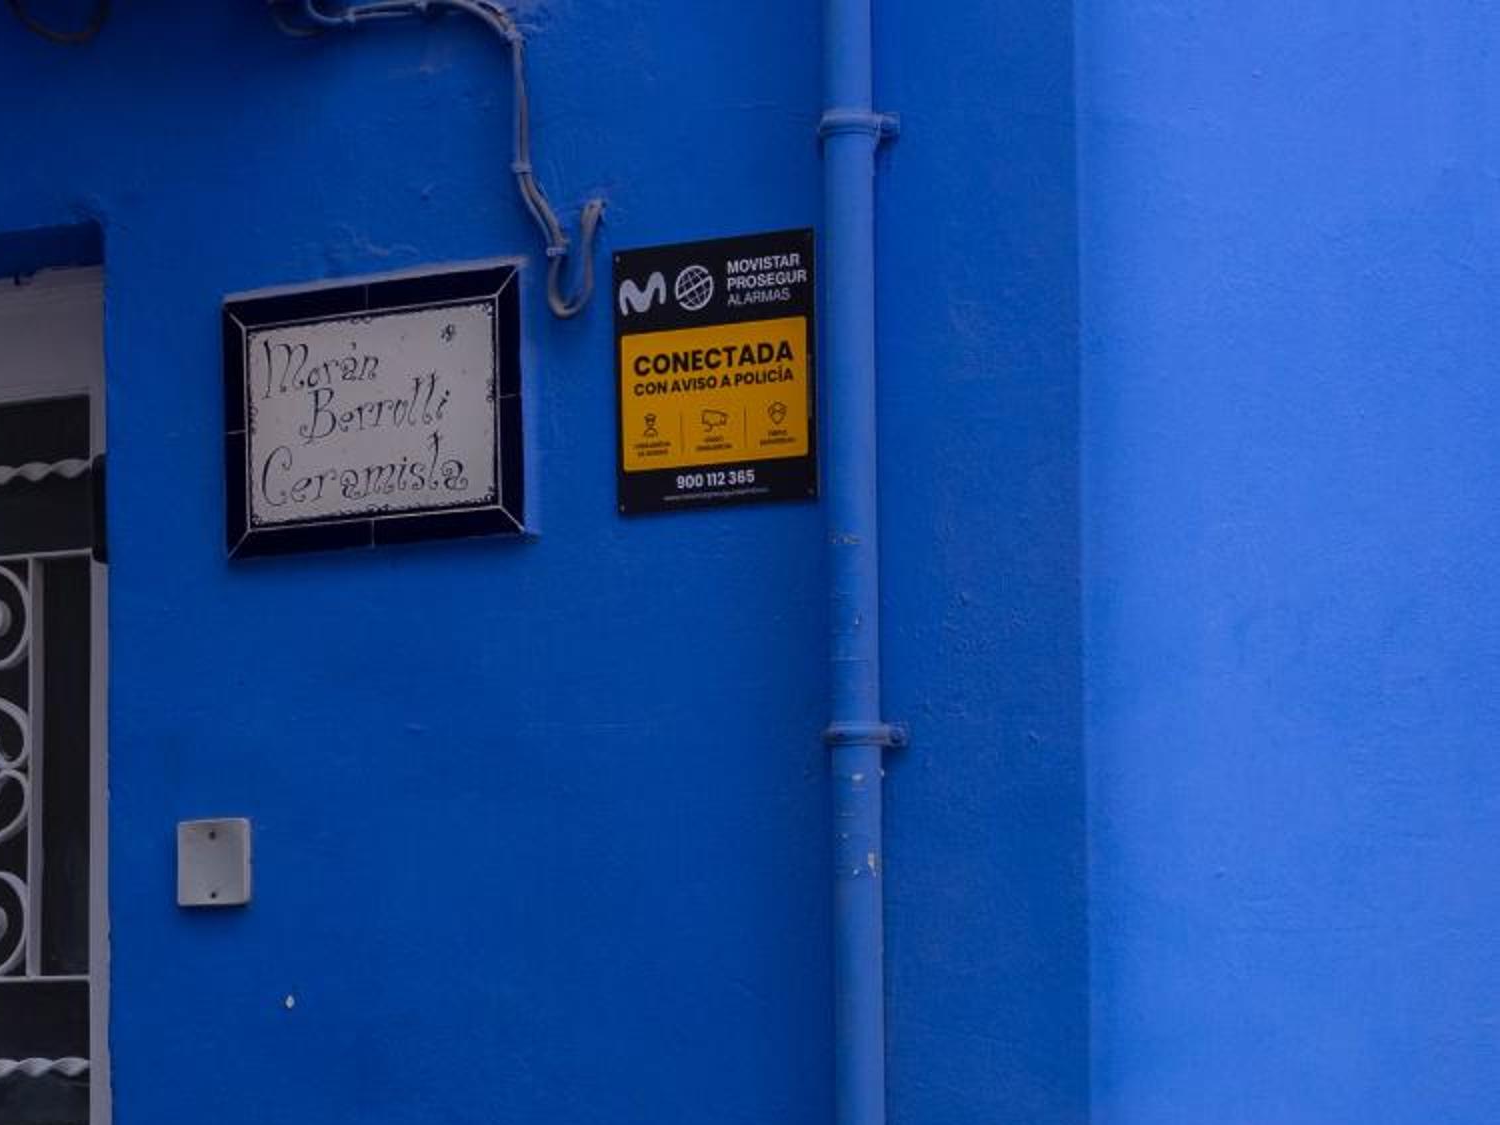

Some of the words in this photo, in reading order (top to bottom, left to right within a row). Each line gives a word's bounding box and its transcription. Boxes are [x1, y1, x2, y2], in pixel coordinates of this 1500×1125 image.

[726, 252, 801, 275] MOVISTAR
[726, 269, 807, 292] PROSEGUR
[727, 287, 792, 306] ALARMAS
[633, 340, 794, 377] CONECTADA
[633, 380, 668, 396] CON
[671, 377, 717, 393] AVISO
[720, 374, 731, 388] A
[735, 367, 794, 386] POLICÍA
[261, 431, 469, 506] Ceramista
[676, 473, 704, 489] 900
[707, 471, 726, 486] 112
[728, 469, 756, 485] 365
